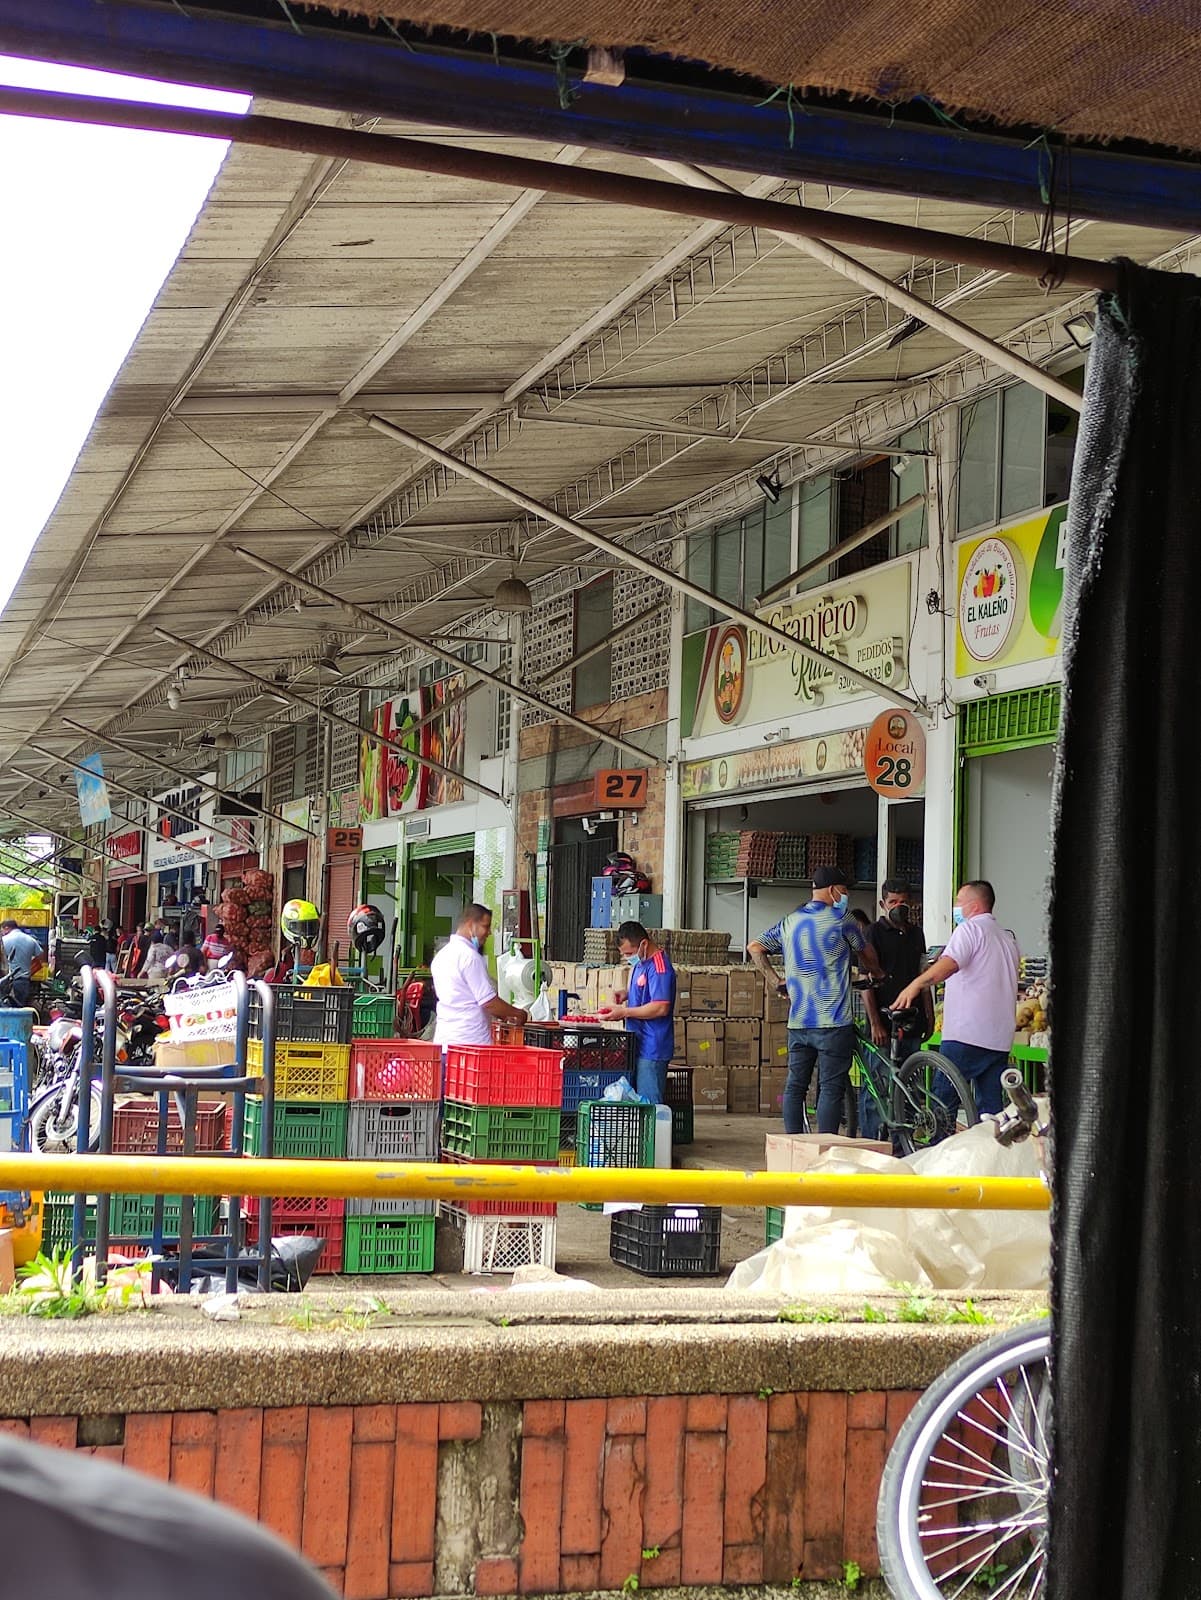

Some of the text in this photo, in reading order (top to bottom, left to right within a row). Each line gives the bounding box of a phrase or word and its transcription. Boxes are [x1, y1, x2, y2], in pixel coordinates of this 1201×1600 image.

[967, 606, 977, 623] EL
[978, 595, 1008, 619] KALEÑO
[768, 601, 856, 655] Granjero
[974, 623, 1001, 640] Frutas
[857, 640, 892, 663] PEDIDOS
[878, 737, 914, 755] Local
[876, 756, 912, 788] 28
[606, 775, 643, 798] 27
[334, 831, 361, 848] 25
